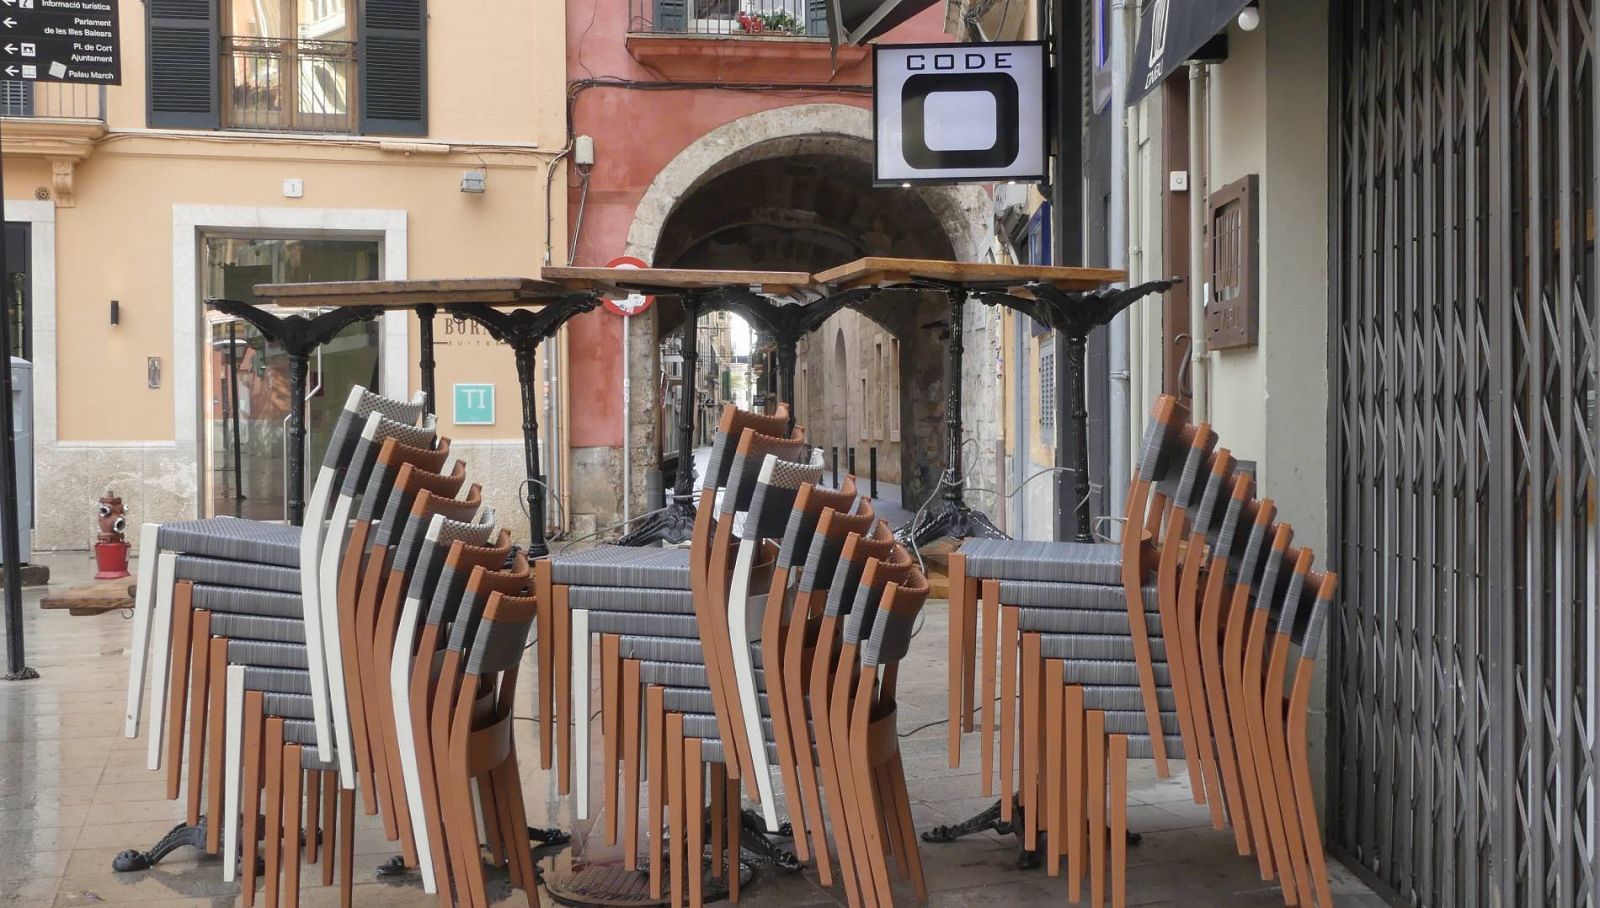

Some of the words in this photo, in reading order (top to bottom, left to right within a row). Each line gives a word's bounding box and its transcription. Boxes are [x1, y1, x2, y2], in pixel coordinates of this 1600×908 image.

[42, 0, 80, 9] Informació
[74, 17, 112, 27] Parlament
[55, 27, 67, 35] les
[68, 28, 83, 36] Illes
[84, 29, 112, 38] Balears
[96, 44, 113, 52] Cort
[71, 54, 113, 63] Ajuntament
[906, 52, 1012, 70] CODE
[68, 70, 89, 78] Palau
[90, 71, 114, 80] March
